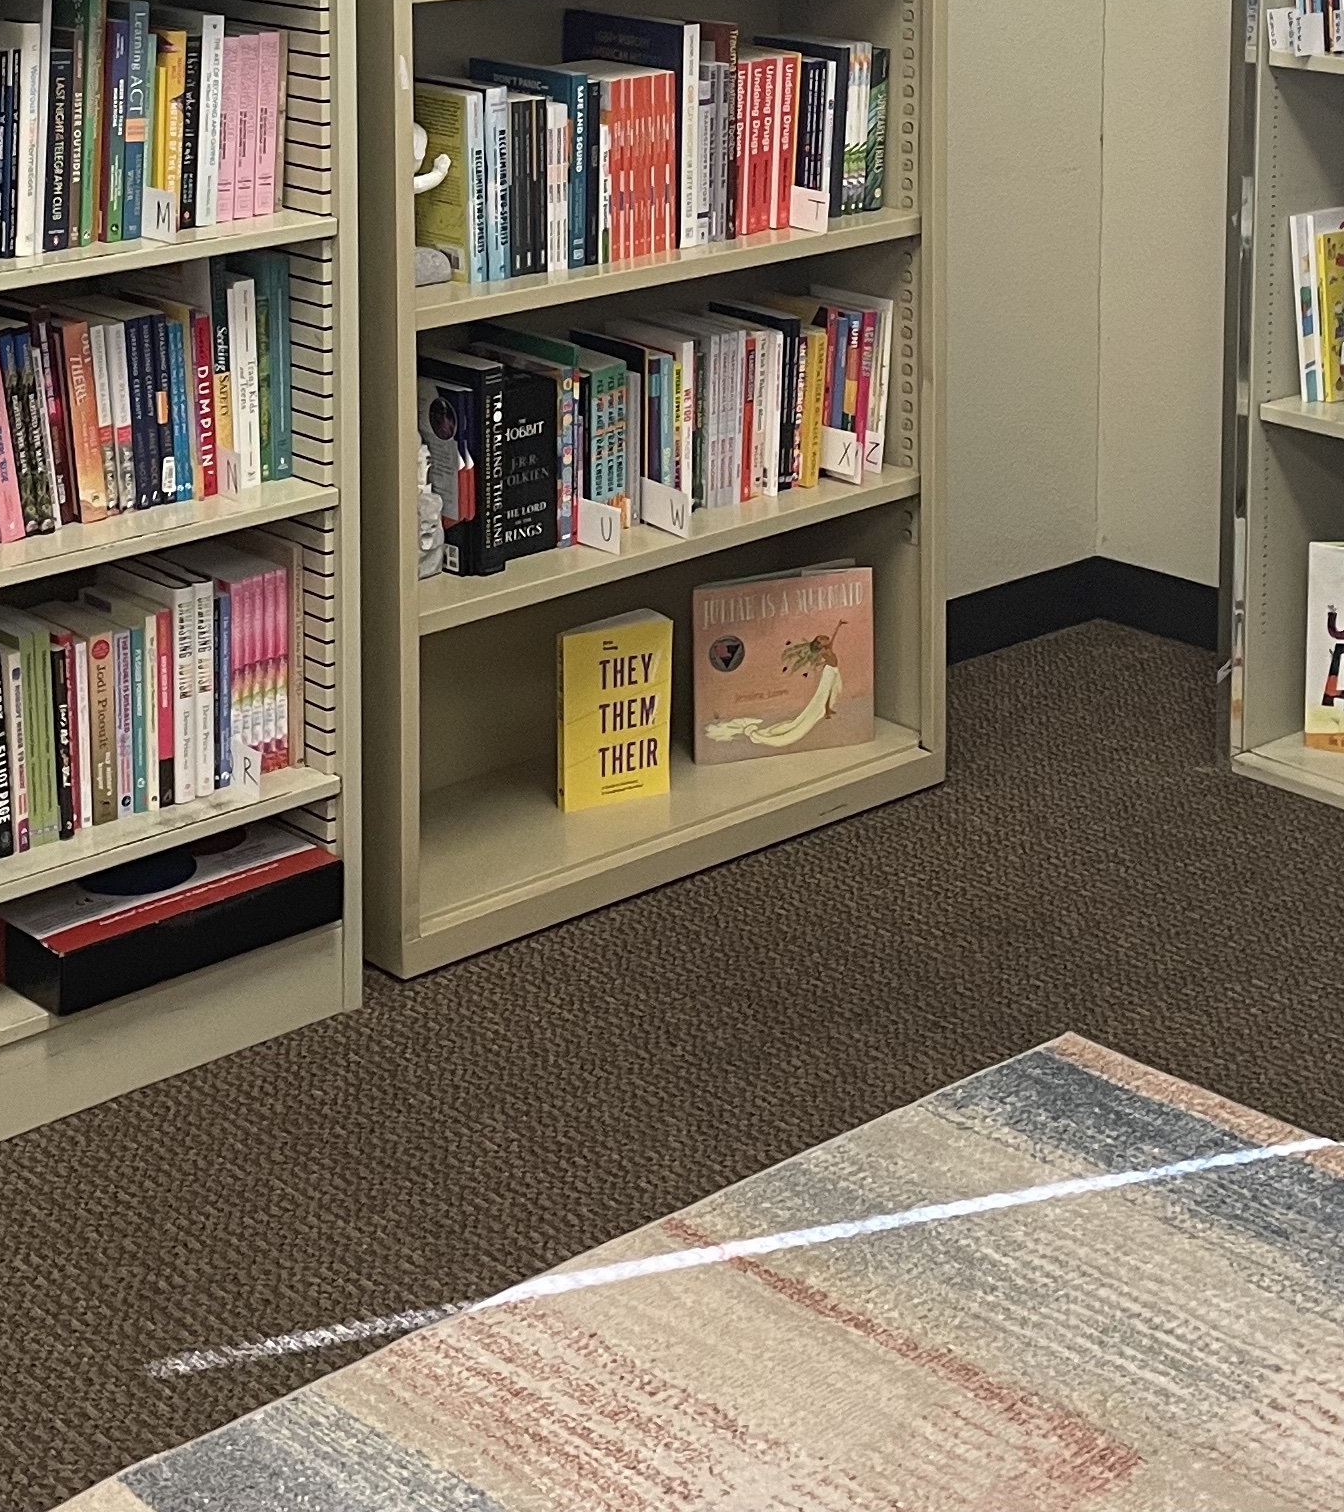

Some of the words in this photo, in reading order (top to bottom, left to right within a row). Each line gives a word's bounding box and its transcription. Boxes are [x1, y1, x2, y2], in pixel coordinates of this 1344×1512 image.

[129, 12, 146, 71] Learning
[74, 93, 82, 127] SISTER
[129, 75, 144, 116] ACT
[576, 85, 584, 111] SAFE
[752, 68, 762, 117] Undoing
[576, 113, 584, 134] AND
[751, 120, 760, 155] Drugs
[72, 130, 82, 184] OUTSIDER
[576, 137, 584, 173] SOUND
[808, 198, 826, 221] T
[69, 355, 87, 407] THERE
[197, 365, 214, 475] DUMPLIN'
[492, 391, 503, 478] TROUBLING
[838, 441, 852, 467] X
[493, 481, 503, 511] THE
[493, 515, 504, 548] LINE
[601, 516, 613, 542] U
[670, 499, 685, 530] W
[505, 523, 543, 543] RINGS
[96, 665, 106, 693] Jodi
[598, 652, 653, 690] THEY
[97, 697, 107, 749] Picoult
[598, 695, 657, 734] THEM
[243, 757, 258, 785] R
[598, 738, 658, 778] THEIR
